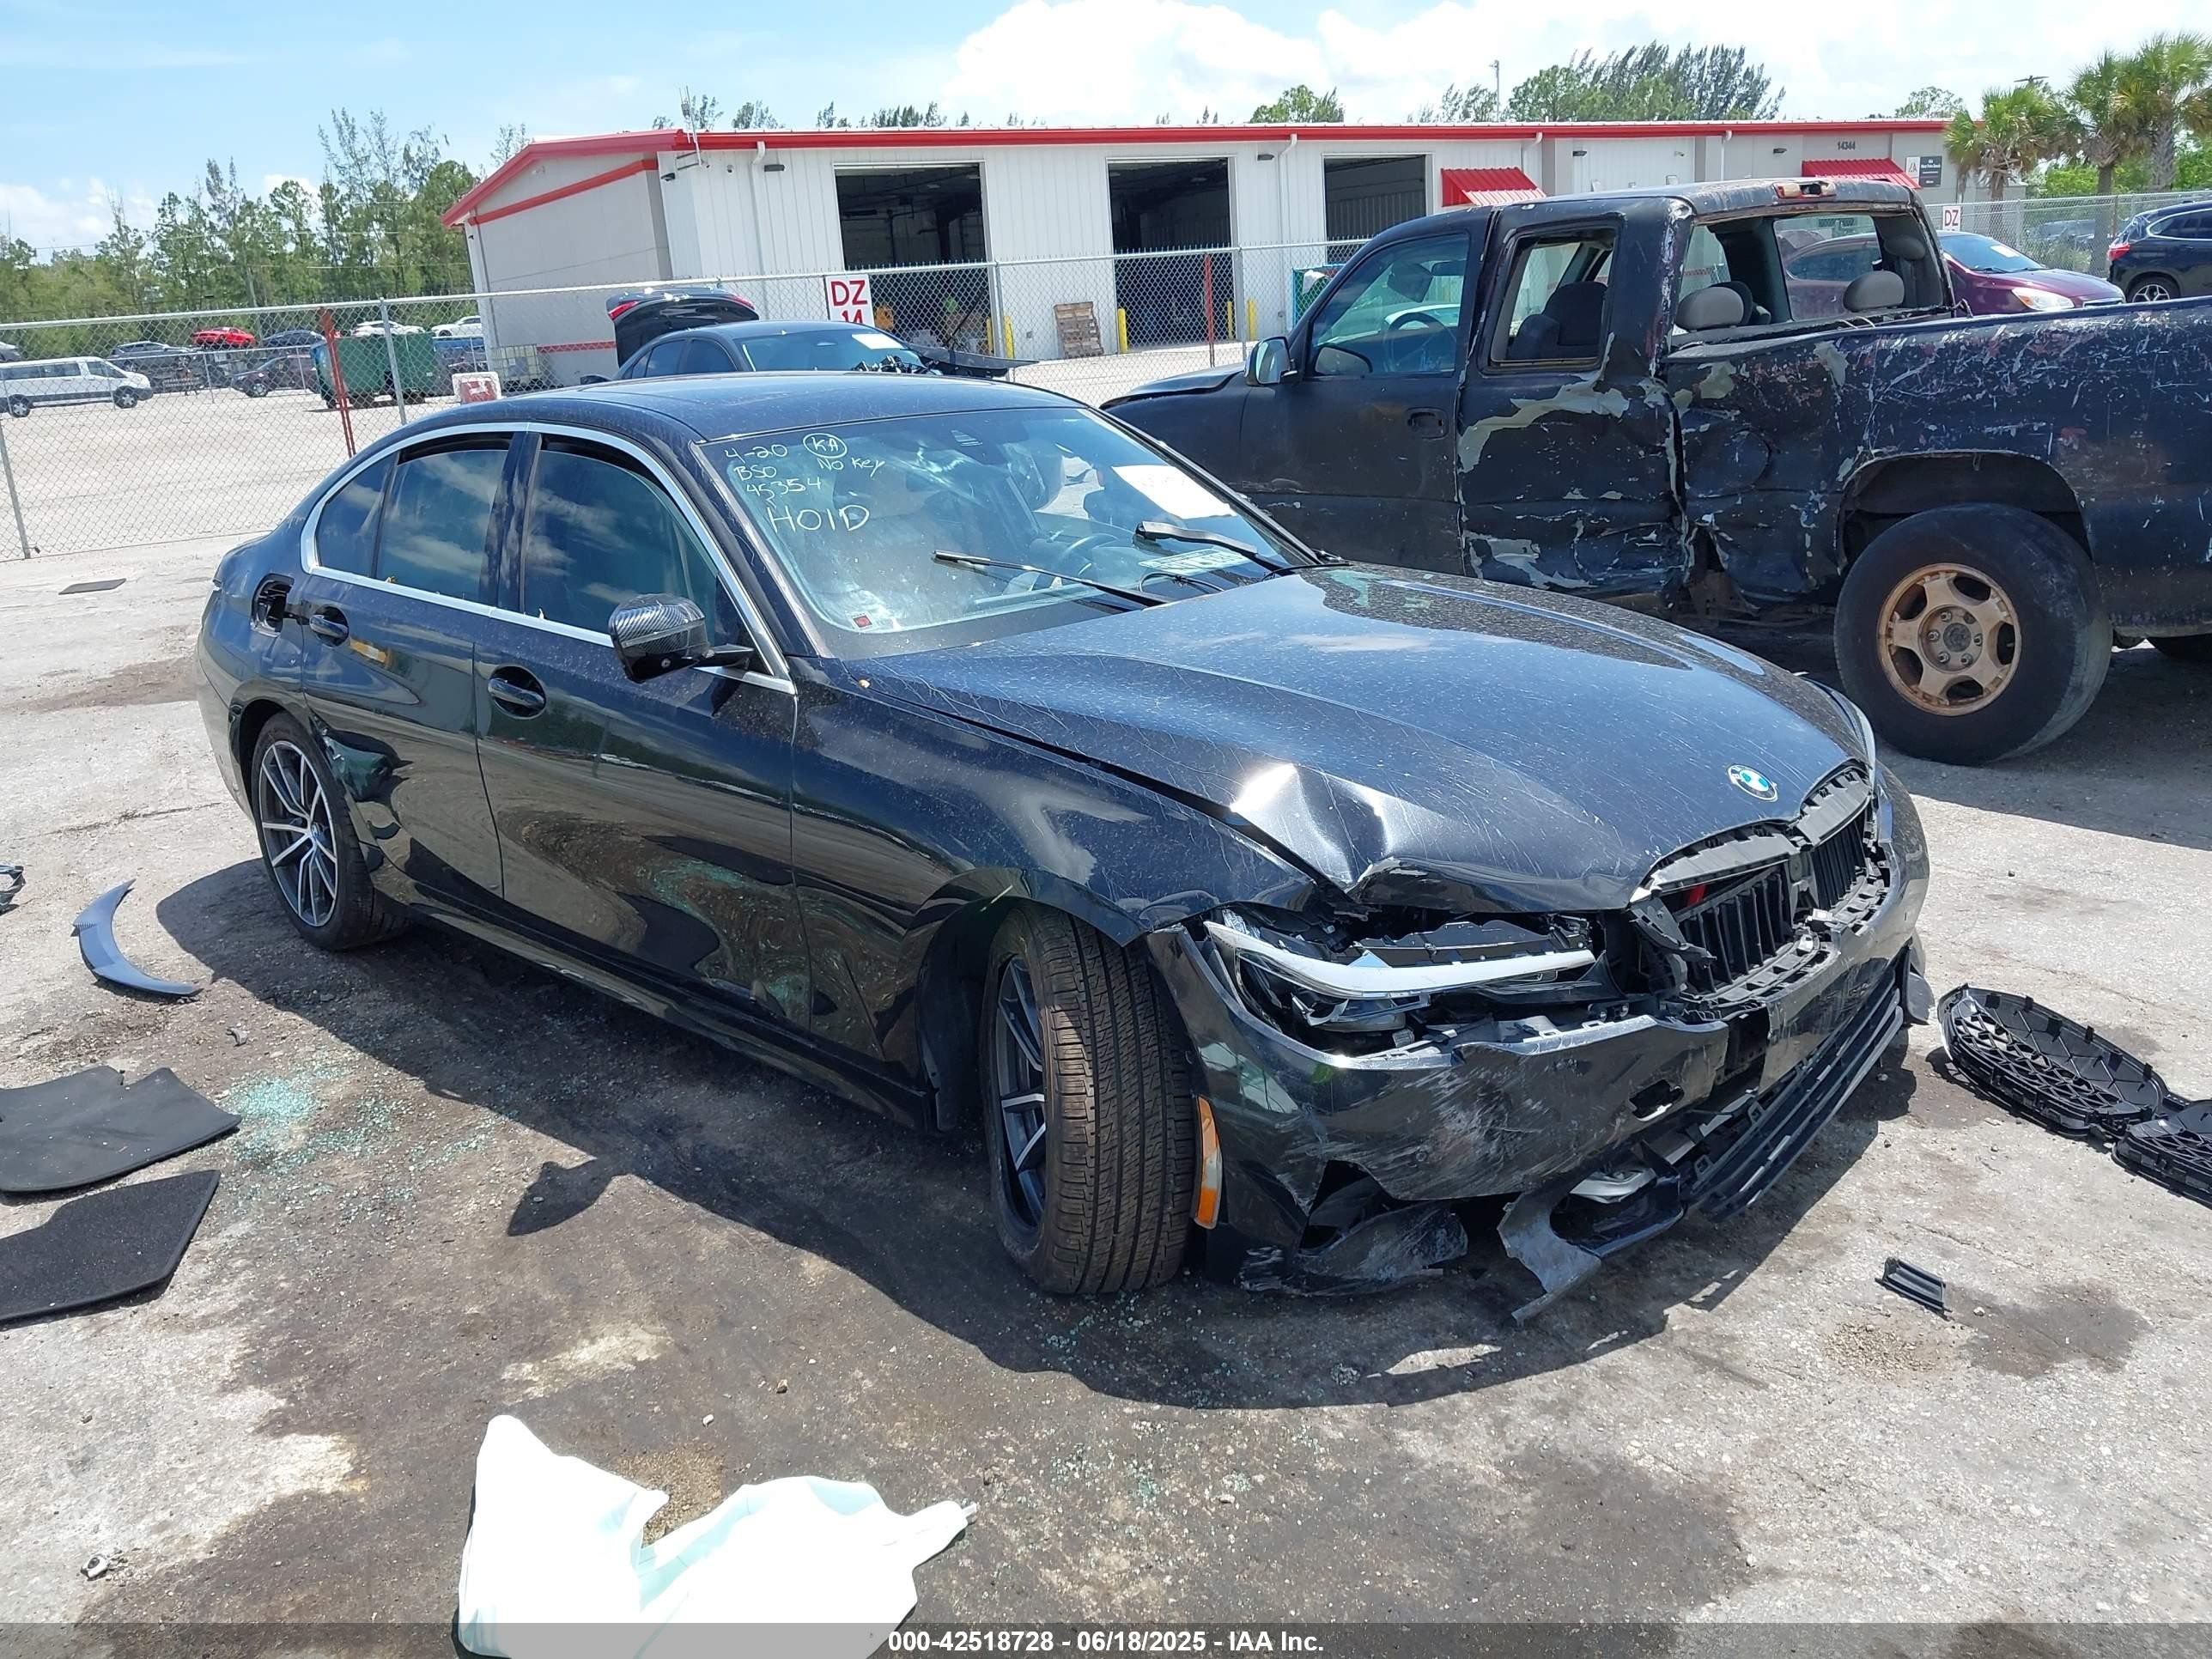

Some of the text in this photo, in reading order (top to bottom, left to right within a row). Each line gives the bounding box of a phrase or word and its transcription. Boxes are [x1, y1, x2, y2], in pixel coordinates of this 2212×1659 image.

[1945, 210, 1959, 227] DZ
[830, 280, 868, 307] DZ
[811, 436, 839, 453] KA
[724, 444, 787, 464] 4-20
[817, 457, 844, 471] No
[746, 477, 821, 501] 45354
